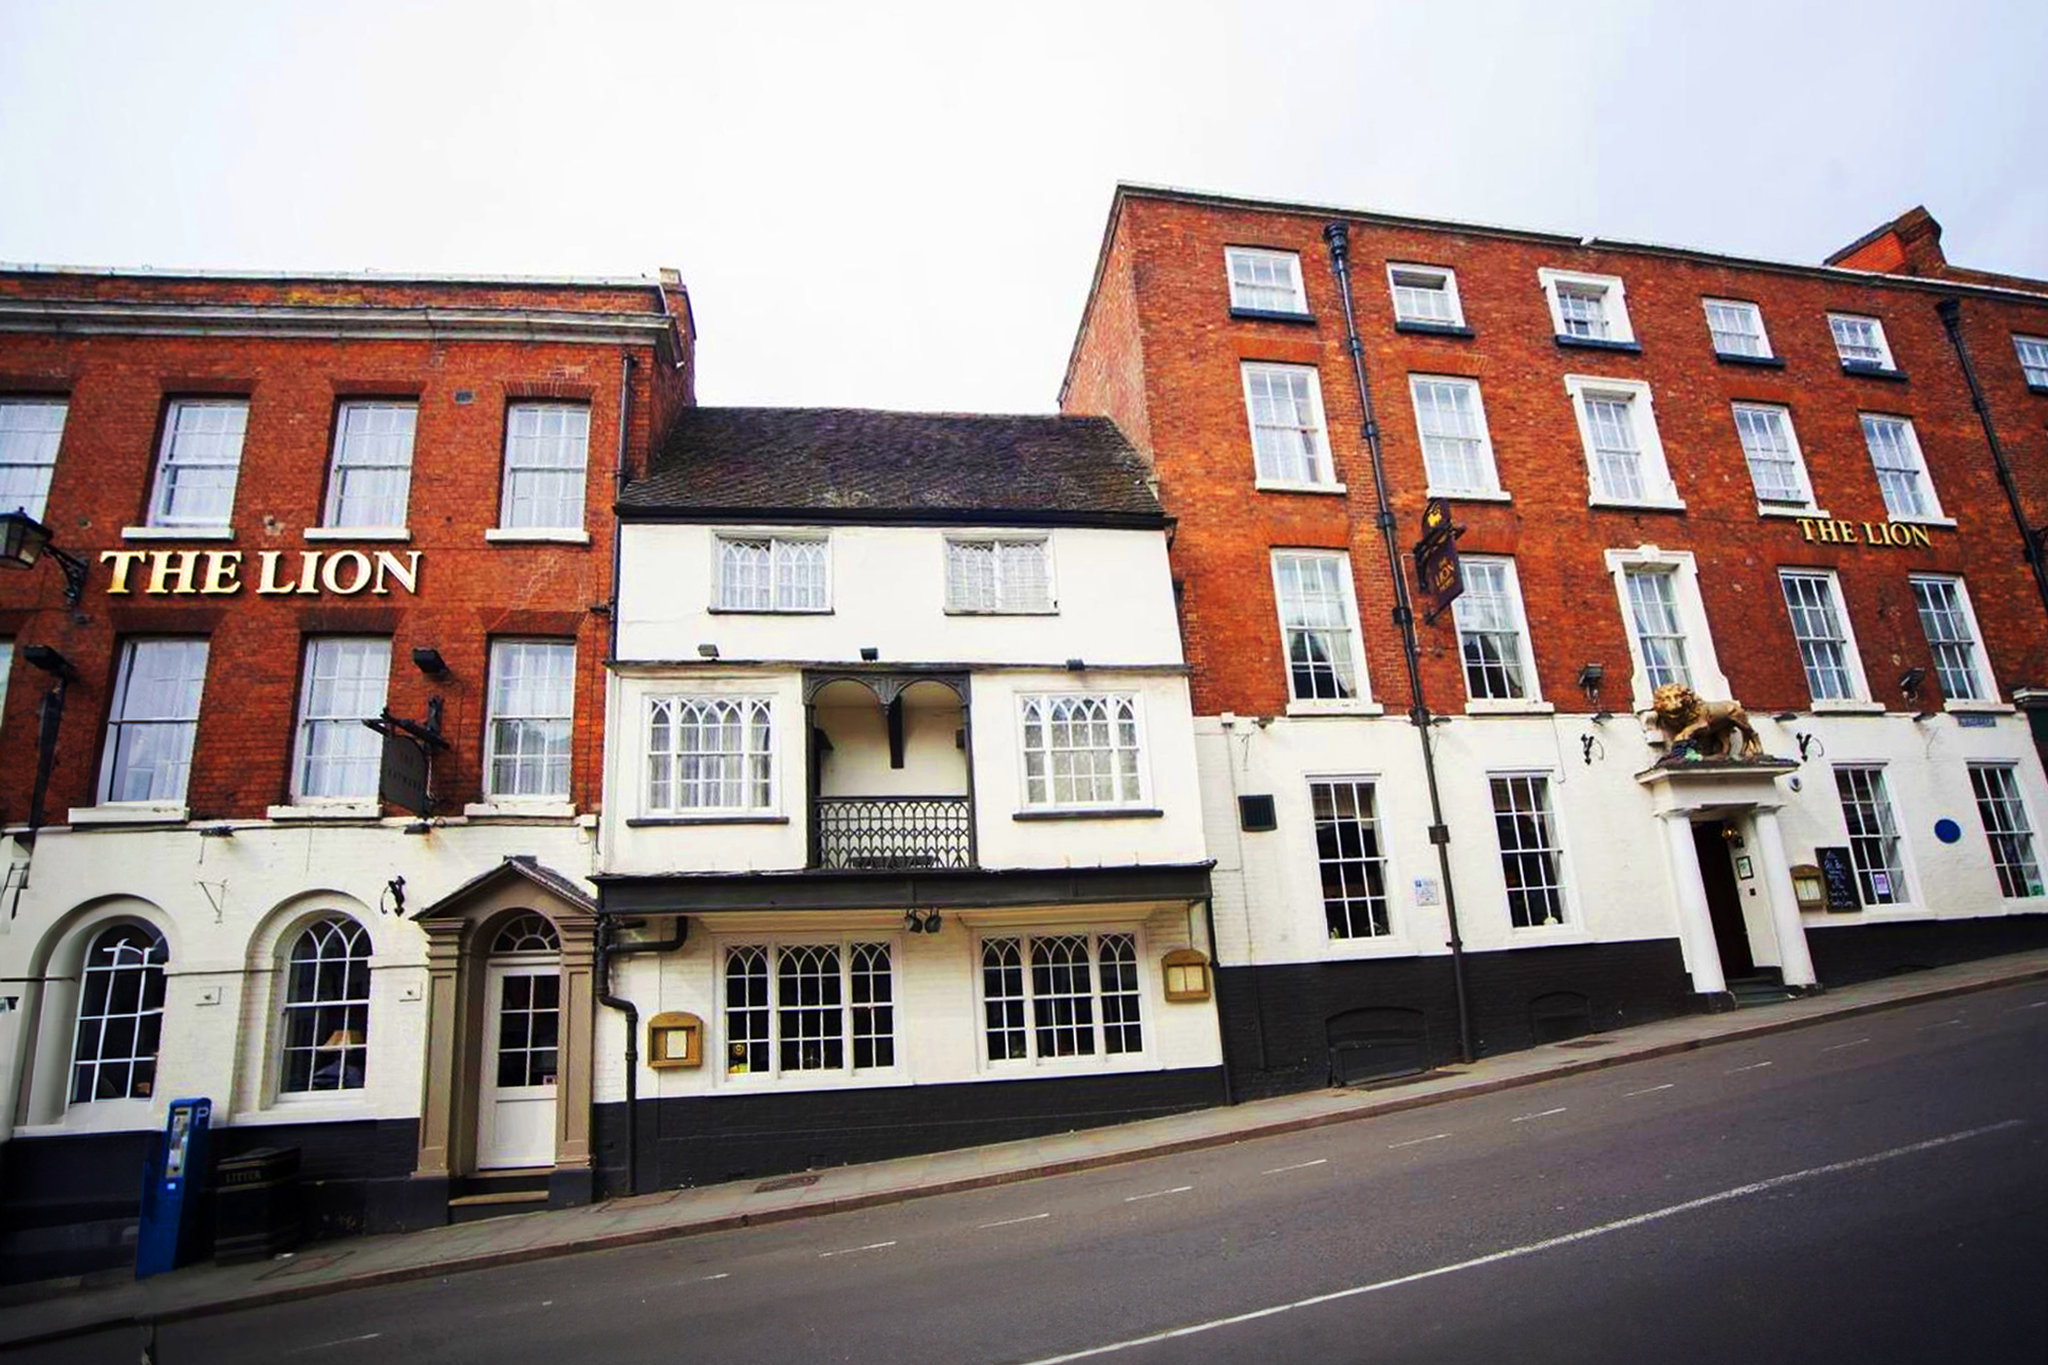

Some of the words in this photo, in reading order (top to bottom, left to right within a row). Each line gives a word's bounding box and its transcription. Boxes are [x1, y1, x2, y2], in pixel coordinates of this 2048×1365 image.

[1796, 518, 1858, 543] THE
[1862, 521, 1932, 547] LION
[100, 550, 243, 594] THE
[256, 550, 423, 595] LION
[194, 1105, 210, 1126] P
